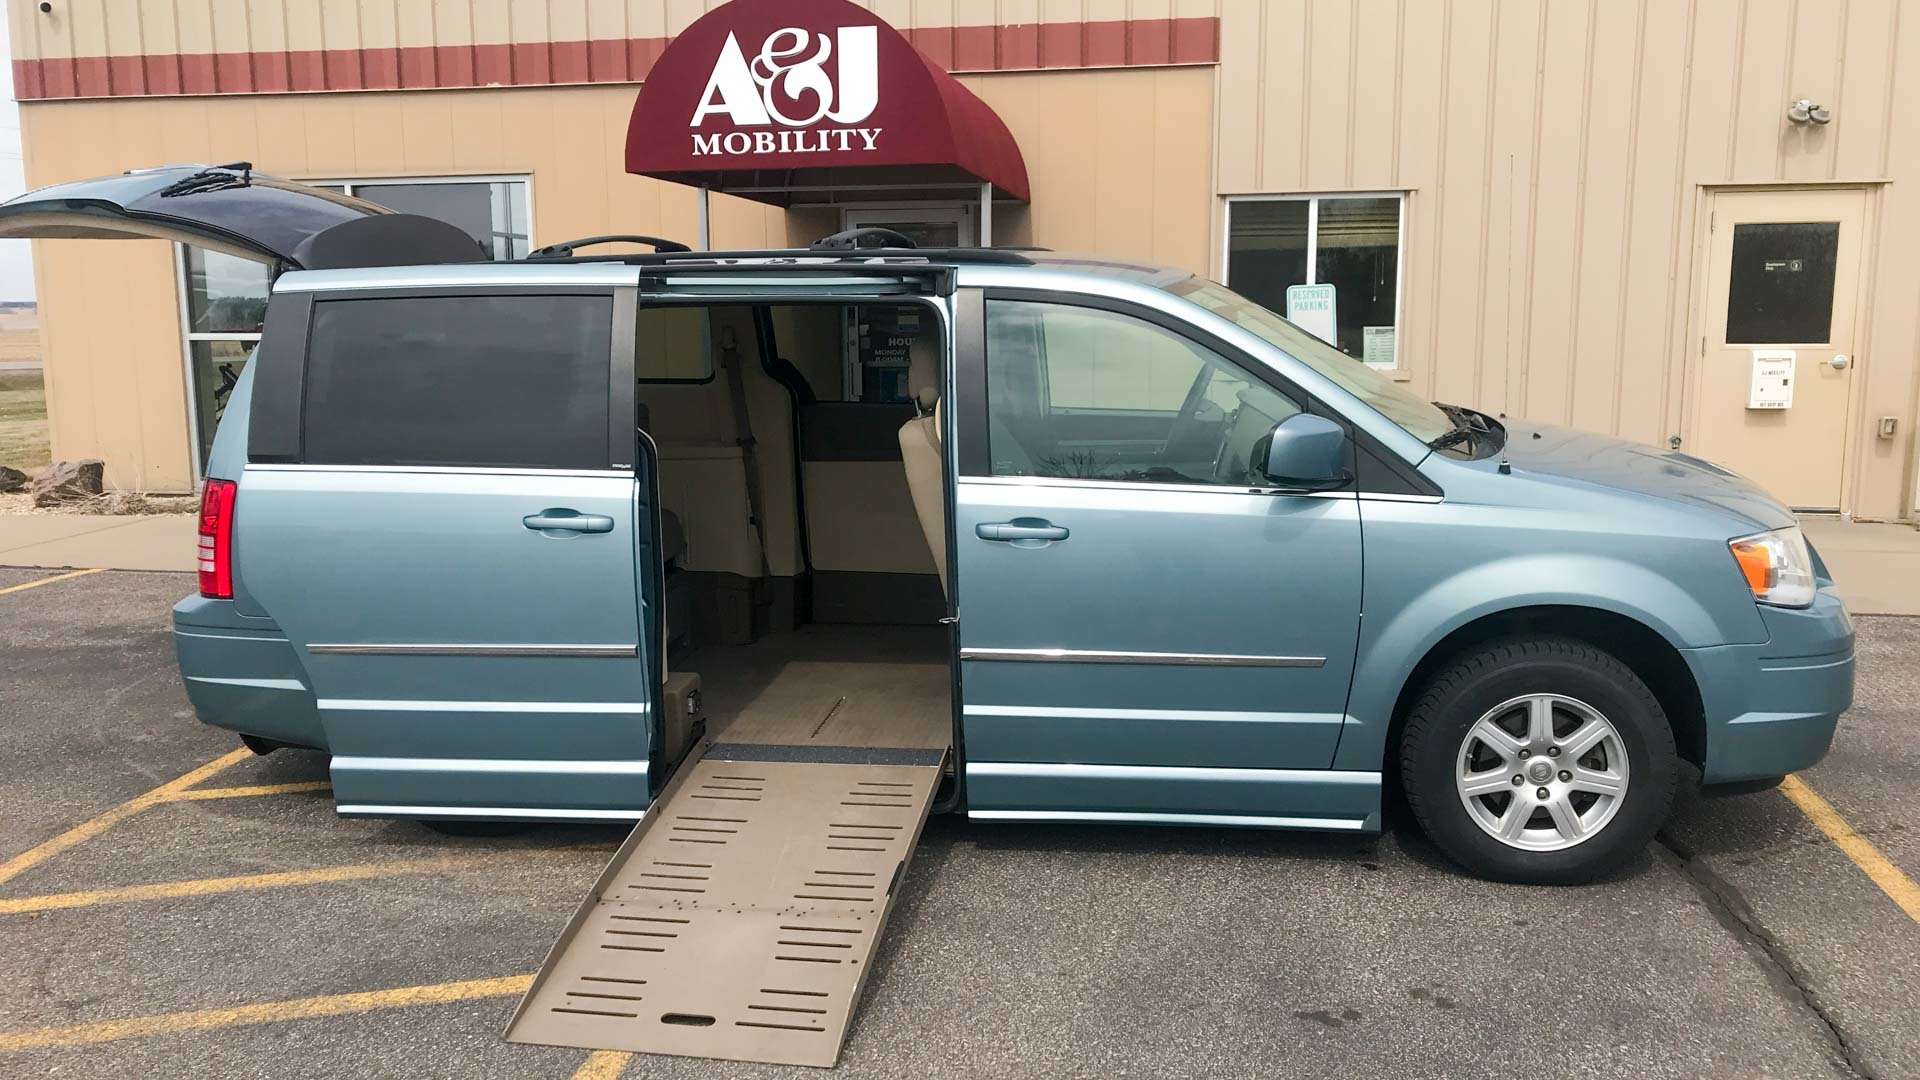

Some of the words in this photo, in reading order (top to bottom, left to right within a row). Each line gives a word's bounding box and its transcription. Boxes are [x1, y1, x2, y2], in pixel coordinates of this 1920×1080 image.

[690, 25, 879, 127] A&J
[691, 128, 882, 156] MOBILITY
[1293, 289, 1329, 300] RESERVED
[1294, 301, 1328, 311] PARKING
[888, 337, 915, 346] HOU
